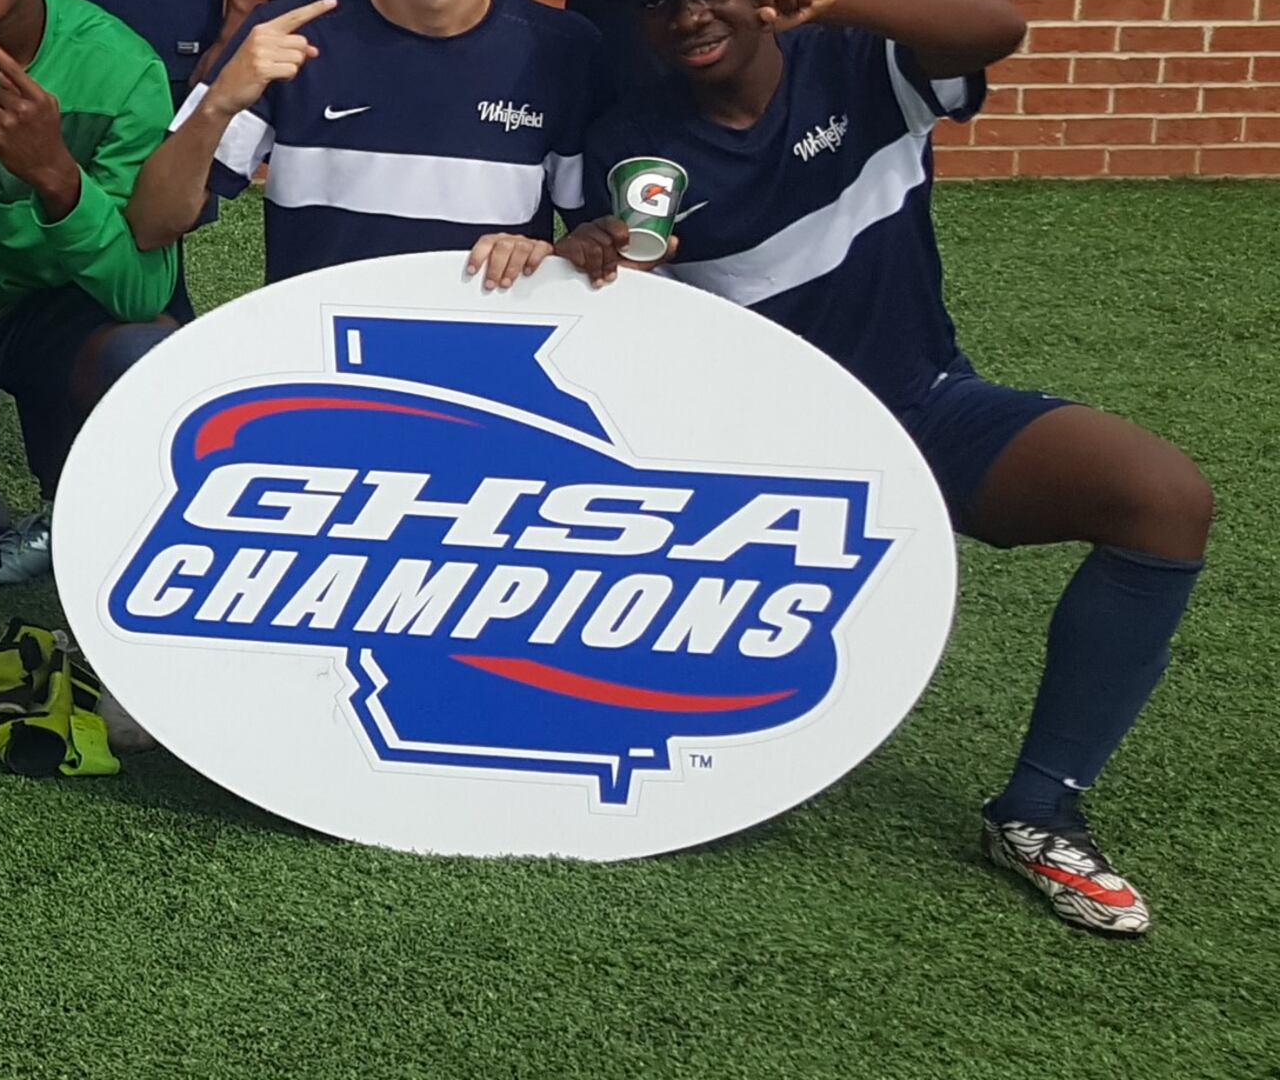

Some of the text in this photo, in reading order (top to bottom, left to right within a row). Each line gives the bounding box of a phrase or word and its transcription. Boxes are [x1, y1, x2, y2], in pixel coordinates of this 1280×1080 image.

[478, 100, 544, 132] Whitefield
[627, 174, 674, 216] G
[182, 463, 860, 569] GHSA
[126, 544, 833, 659] CHAMPIONS
[689, 754, 712, 768] TM
